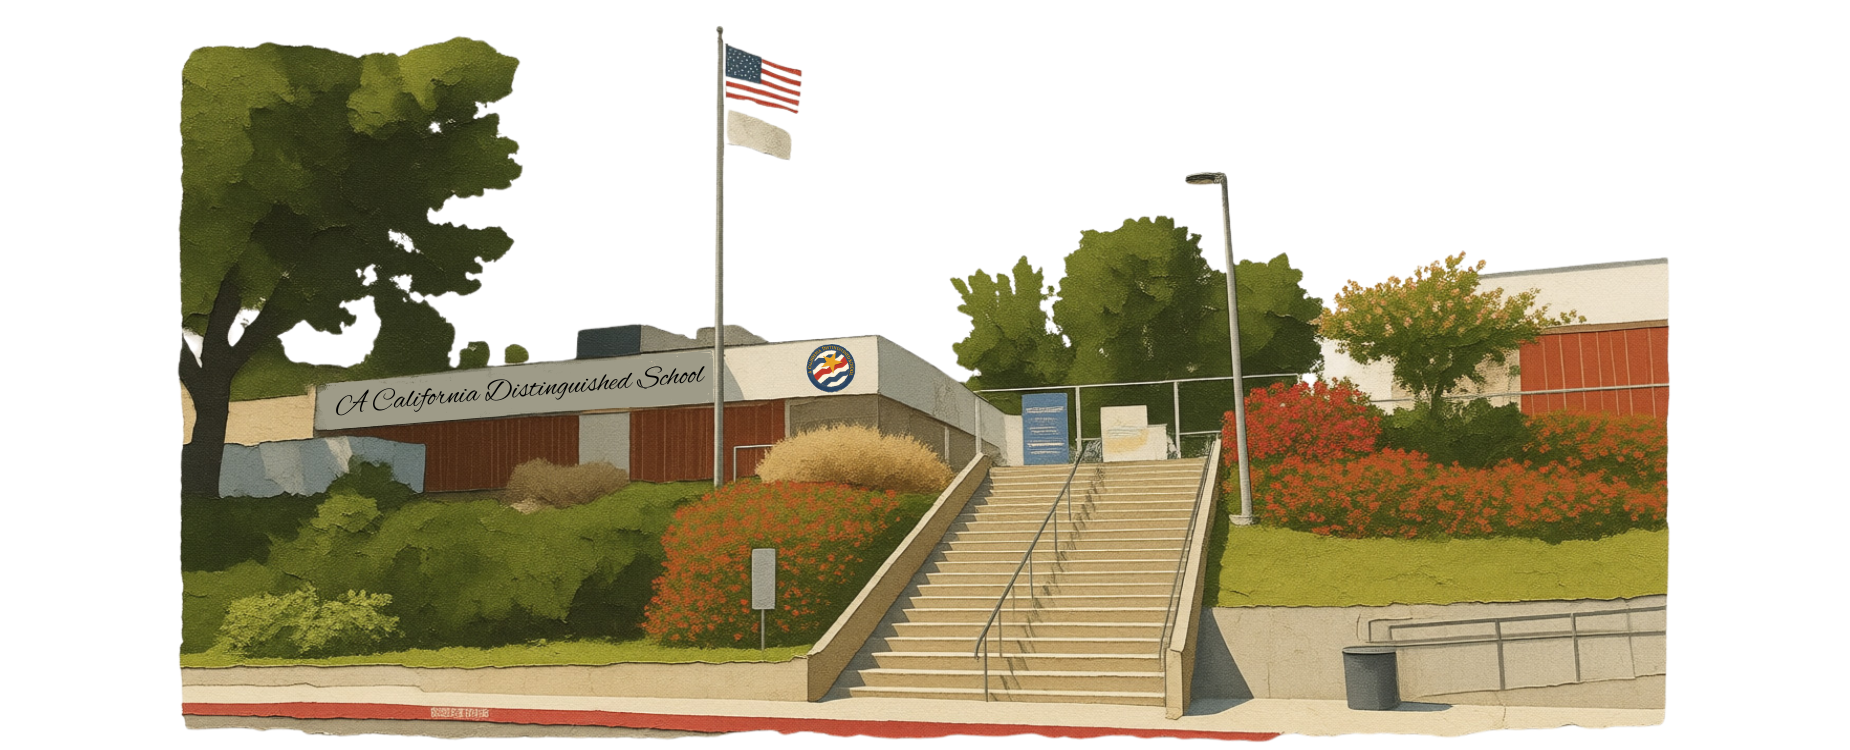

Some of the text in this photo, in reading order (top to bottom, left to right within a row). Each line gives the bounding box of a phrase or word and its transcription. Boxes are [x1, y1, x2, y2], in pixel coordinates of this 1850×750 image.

[336, 365, 706, 416] A California Distinguished School
